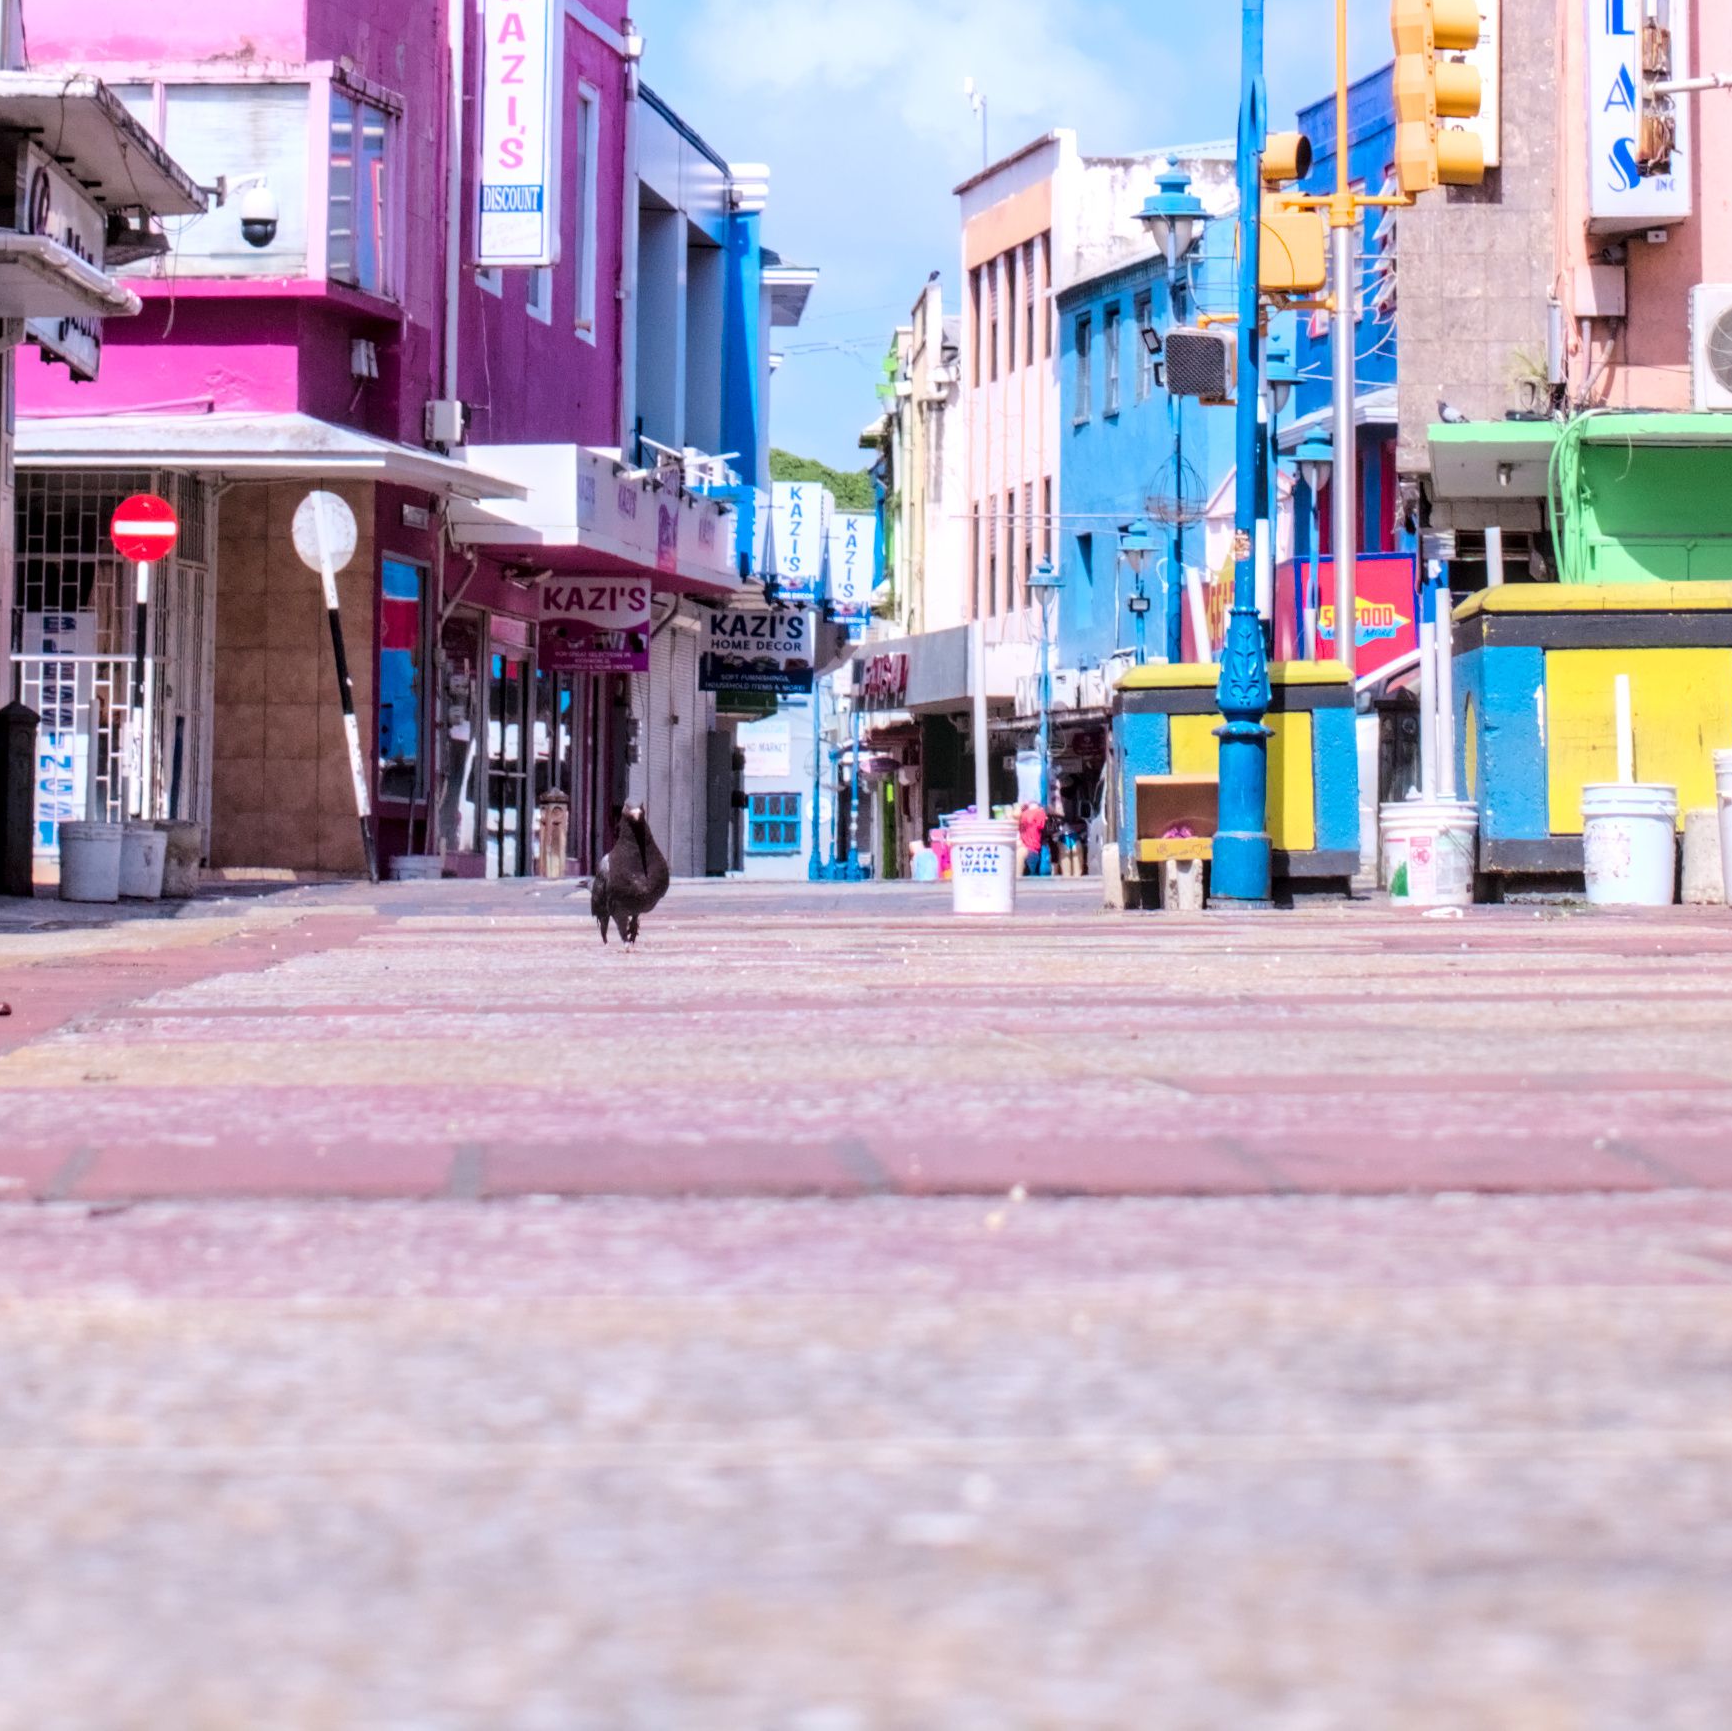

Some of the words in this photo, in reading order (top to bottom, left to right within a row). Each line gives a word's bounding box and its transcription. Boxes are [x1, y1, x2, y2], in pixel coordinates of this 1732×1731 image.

[482, 186, 541, 212] DISCOUNT
[542, 587, 646, 612] KAZI'S
[710, 613, 804, 640] KAZI'S
[711, 639, 750, 651] HOME
[756, 640, 802, 652] DECOR
